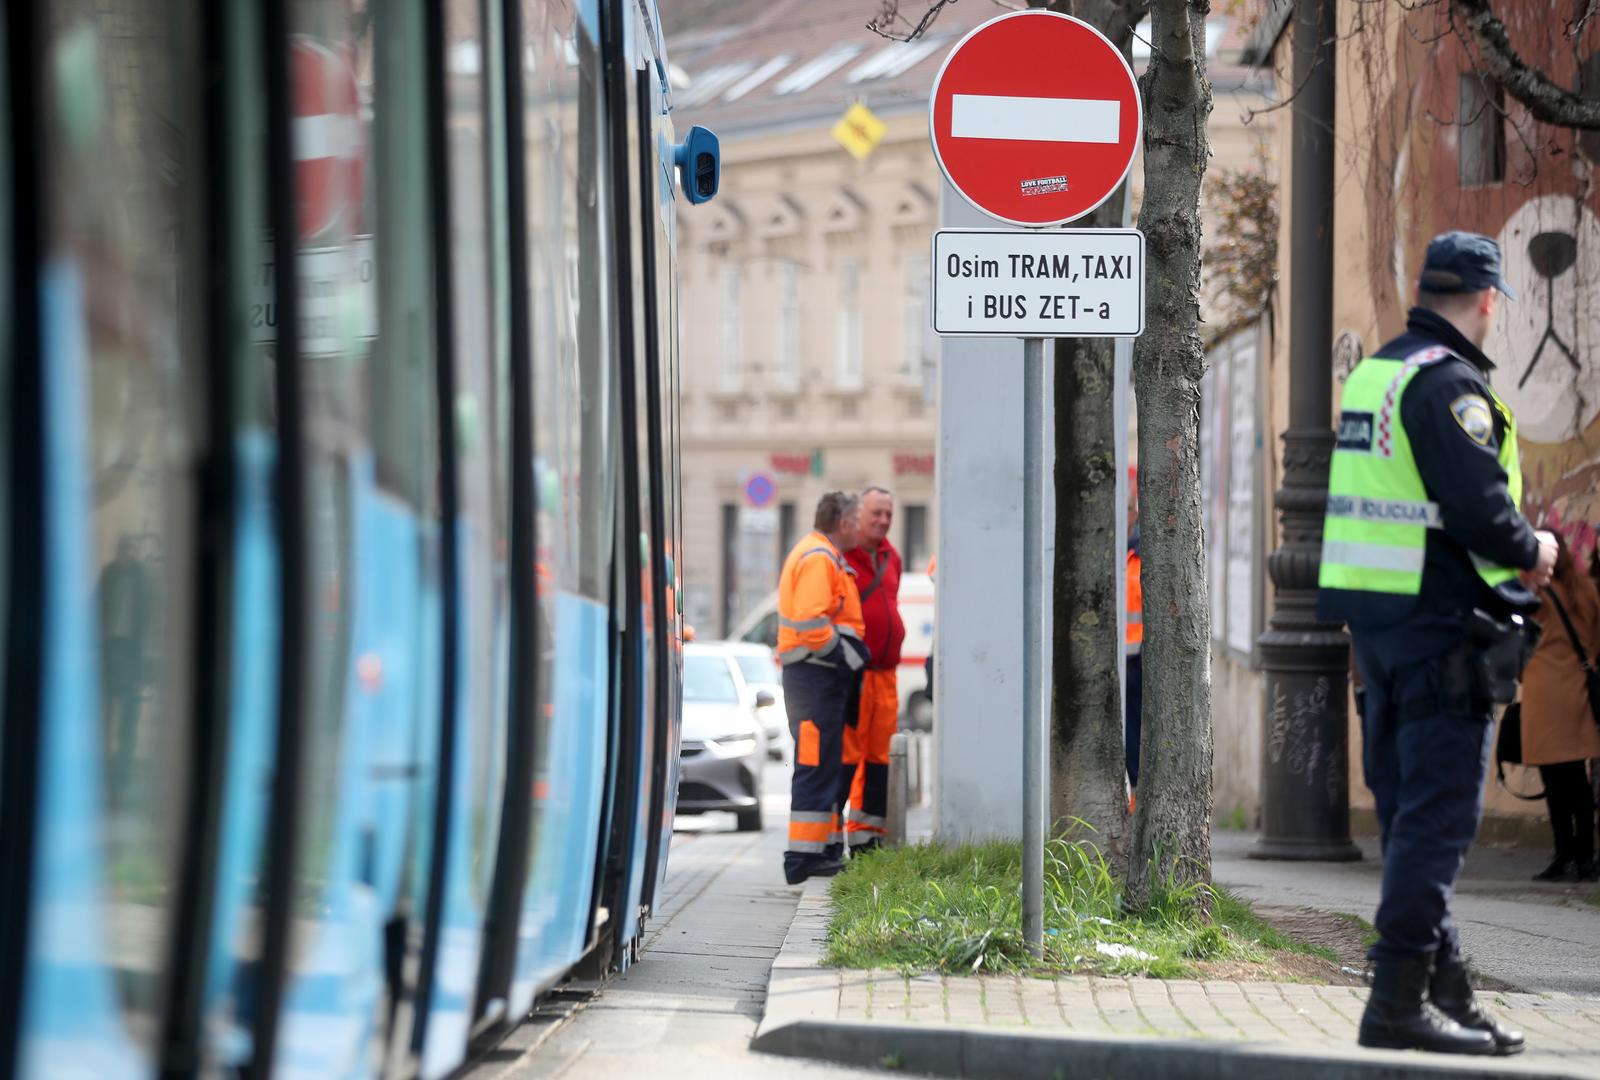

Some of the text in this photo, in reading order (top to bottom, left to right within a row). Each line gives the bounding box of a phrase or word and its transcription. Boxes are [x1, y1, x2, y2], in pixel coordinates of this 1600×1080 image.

[1021, 177, 1067, 188] LOVE FOOTBALL
[947, 253, 999, 278] Osim
[967, 295, 1110, 319] i BUS ZET-a
